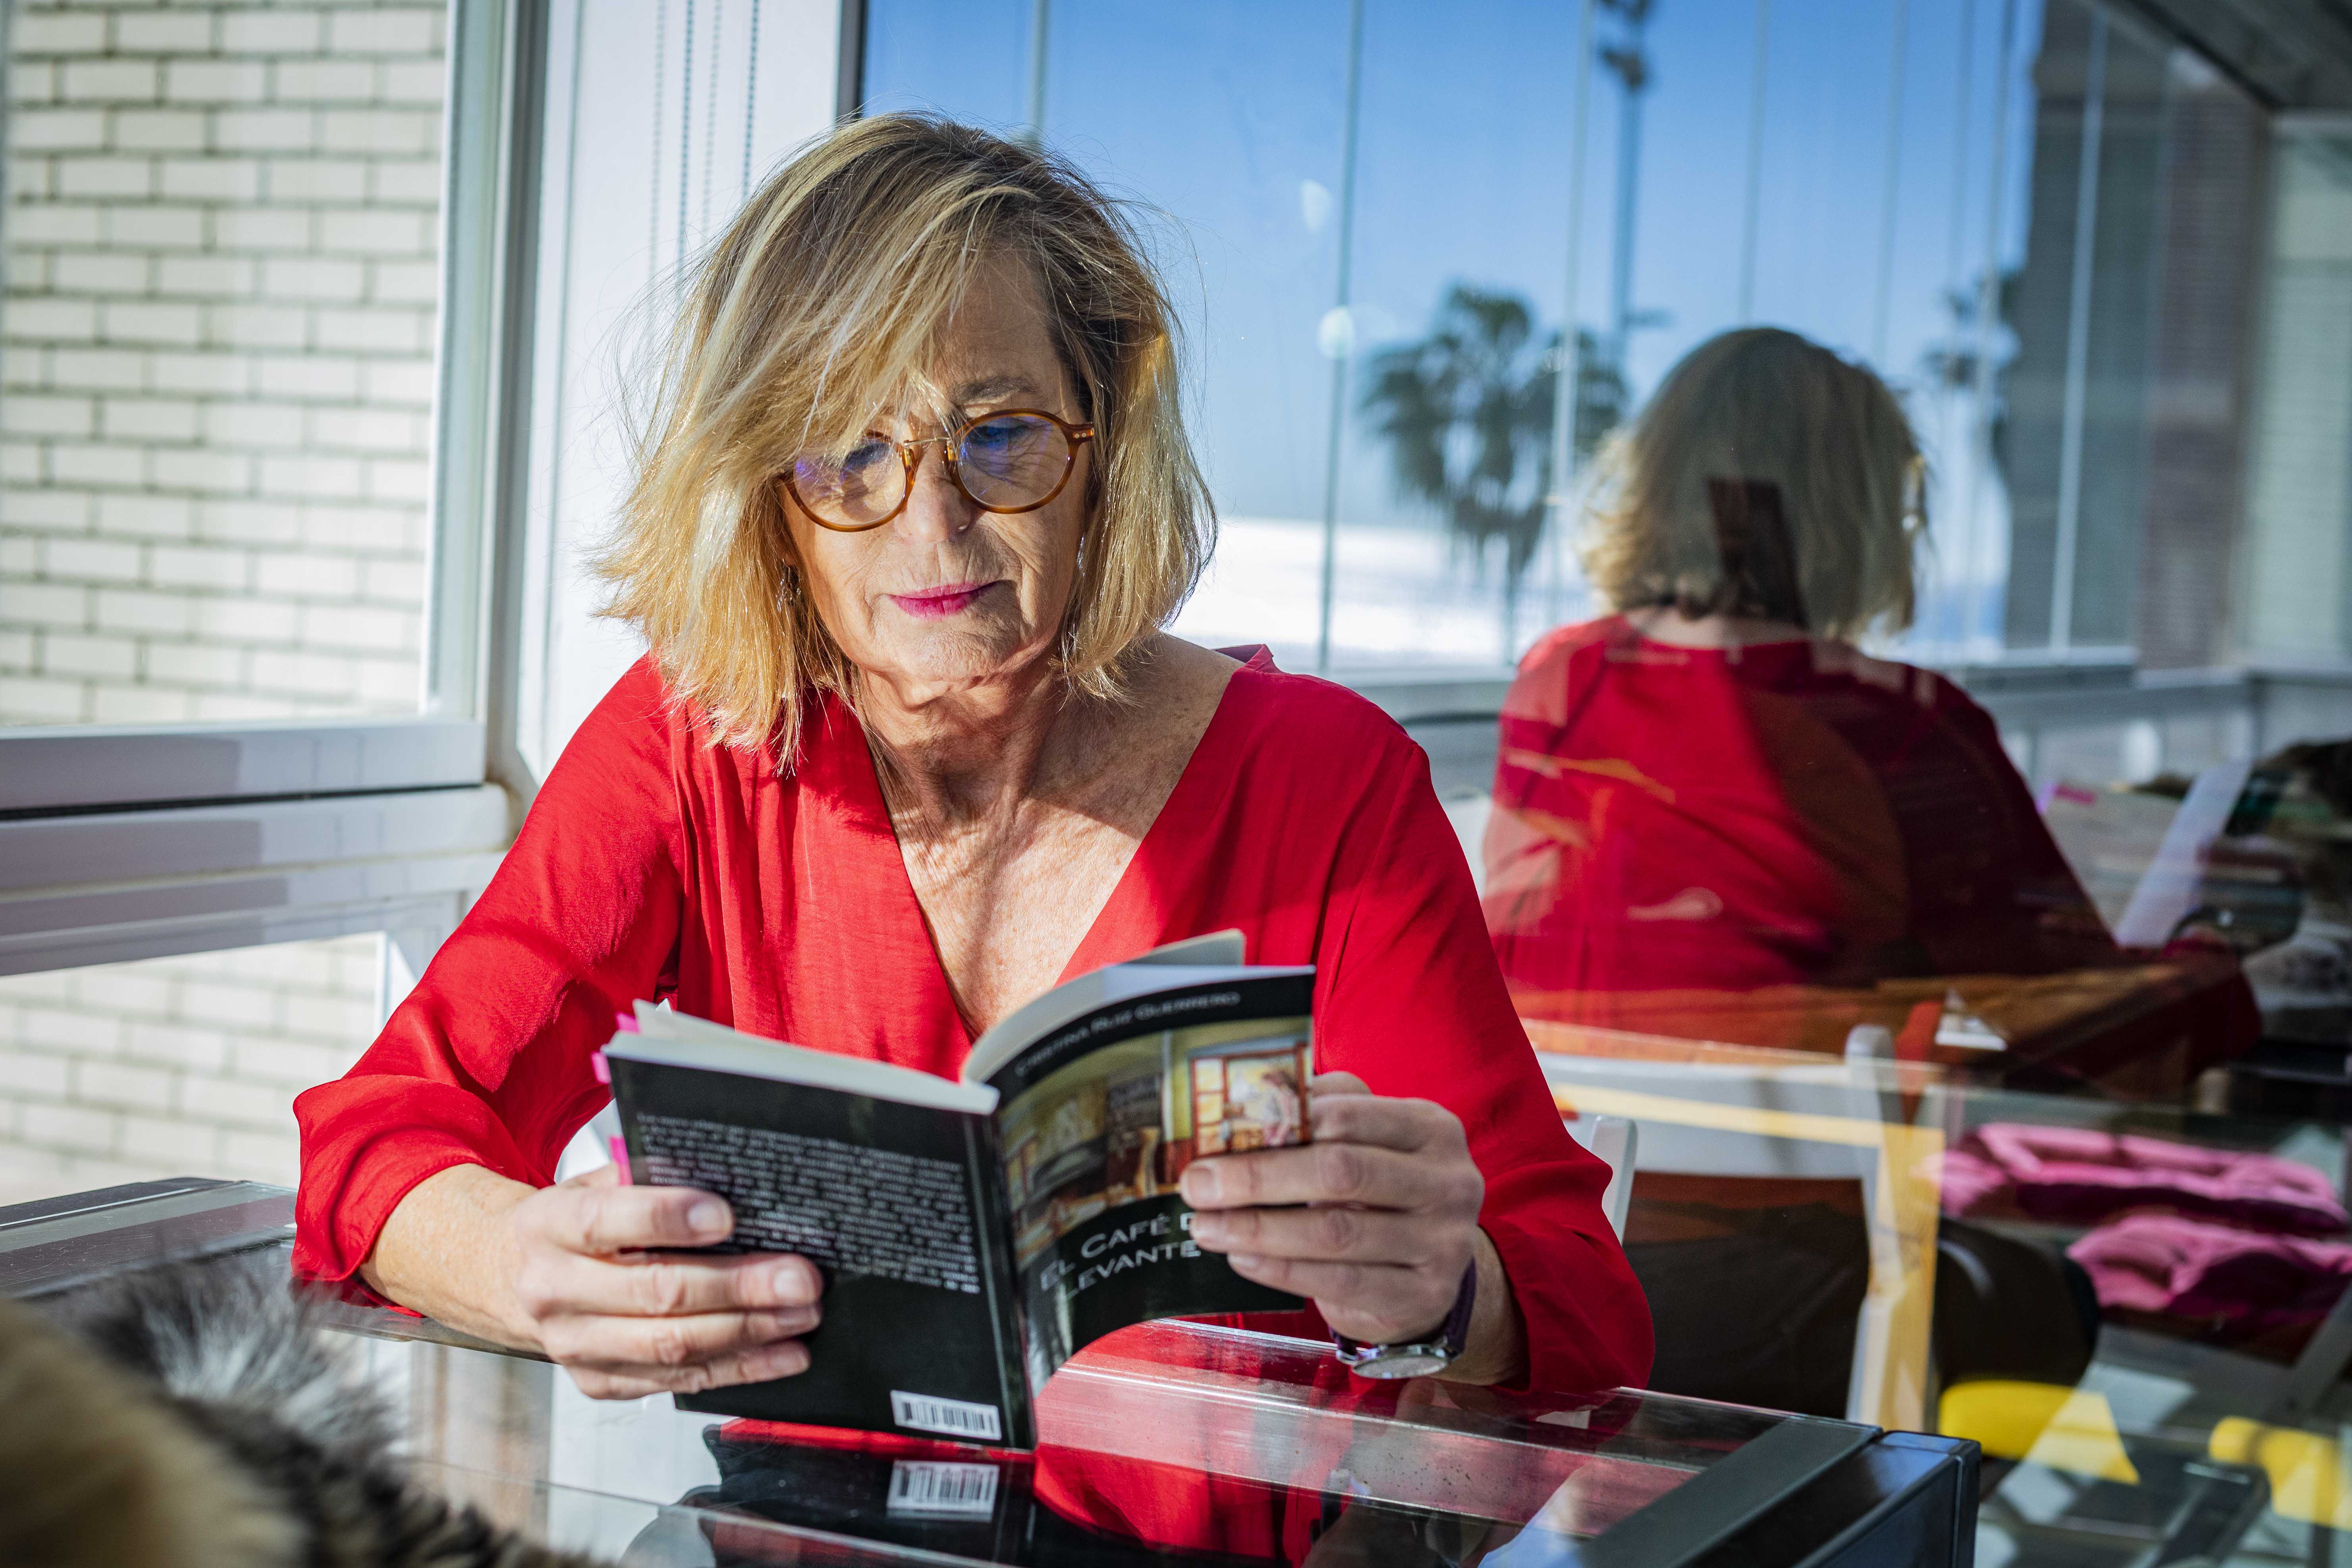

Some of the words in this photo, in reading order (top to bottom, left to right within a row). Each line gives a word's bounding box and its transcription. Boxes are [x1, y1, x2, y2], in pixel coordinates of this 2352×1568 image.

[1040, 1258, 1076, 1291] EL
[1081, 1213, 1171, 1258] CAFÉ
[1063, 1239, 1201, 1300] LEVANTE
